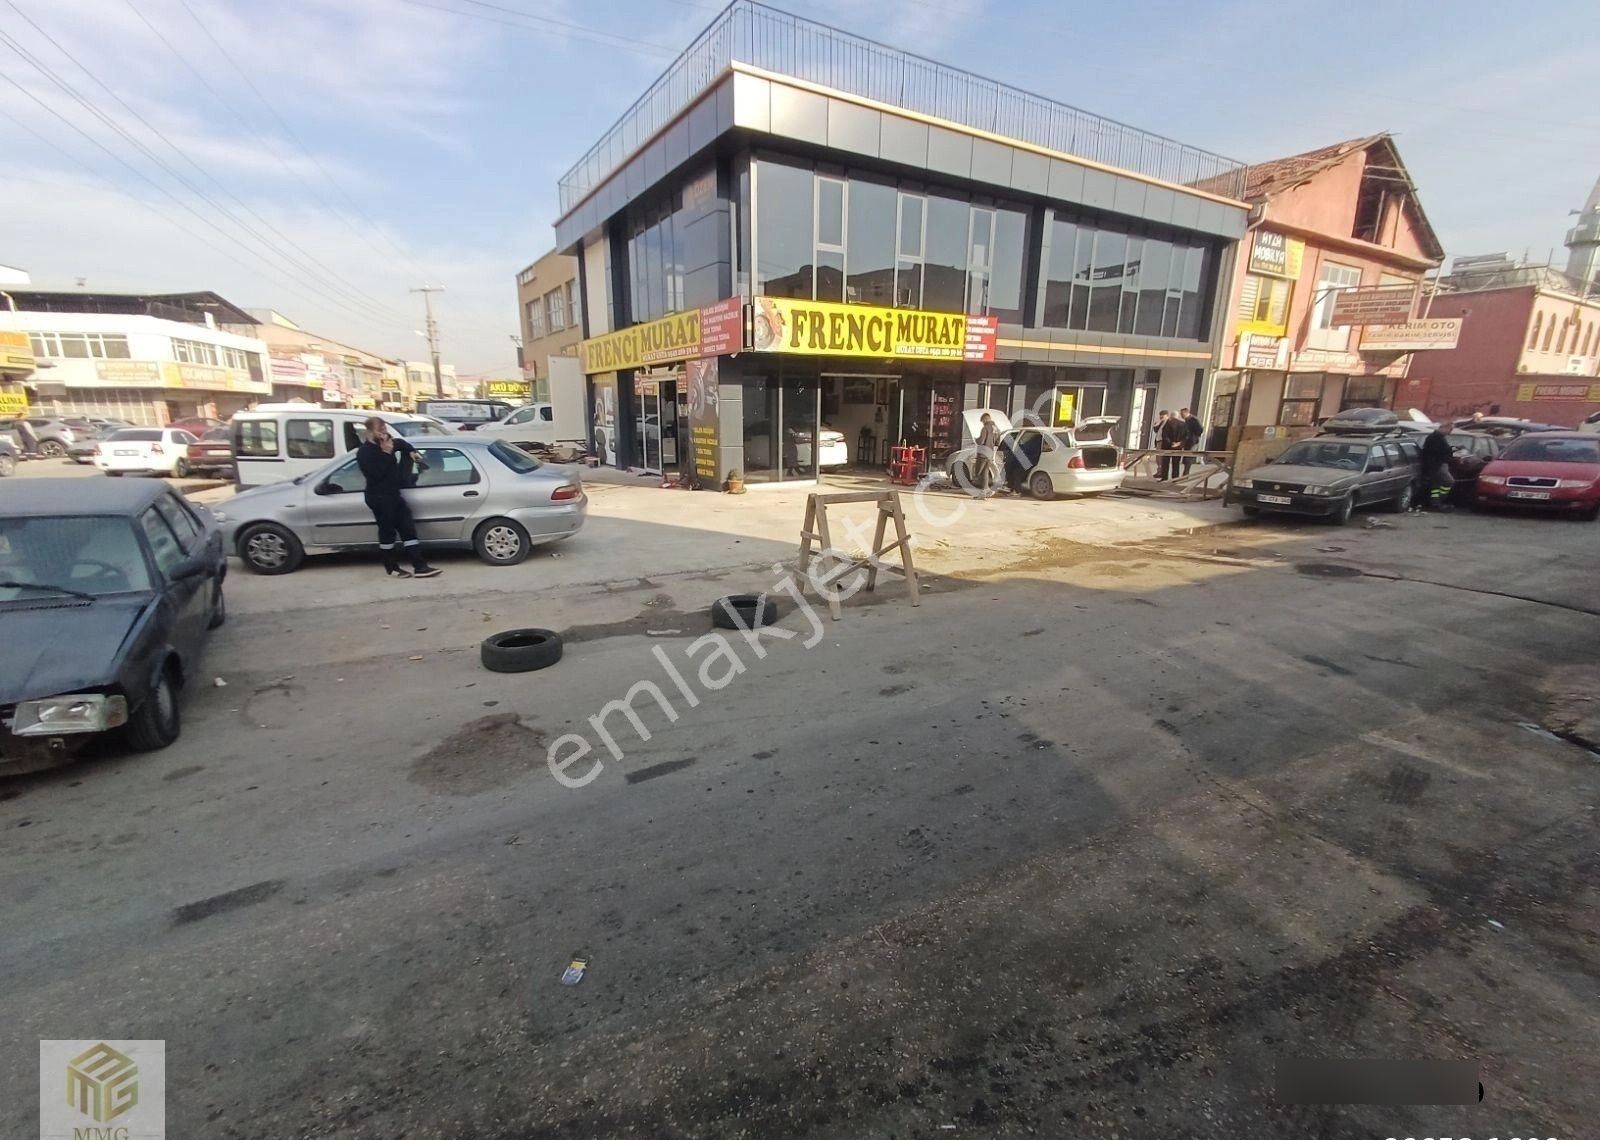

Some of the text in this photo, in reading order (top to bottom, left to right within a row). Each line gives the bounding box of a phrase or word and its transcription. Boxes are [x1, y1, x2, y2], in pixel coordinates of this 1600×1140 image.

[640, 313, 699, 353] MURAT
[896, 313, 963, 346] MURAT
[1430, 321, 1456, 330] OTO
